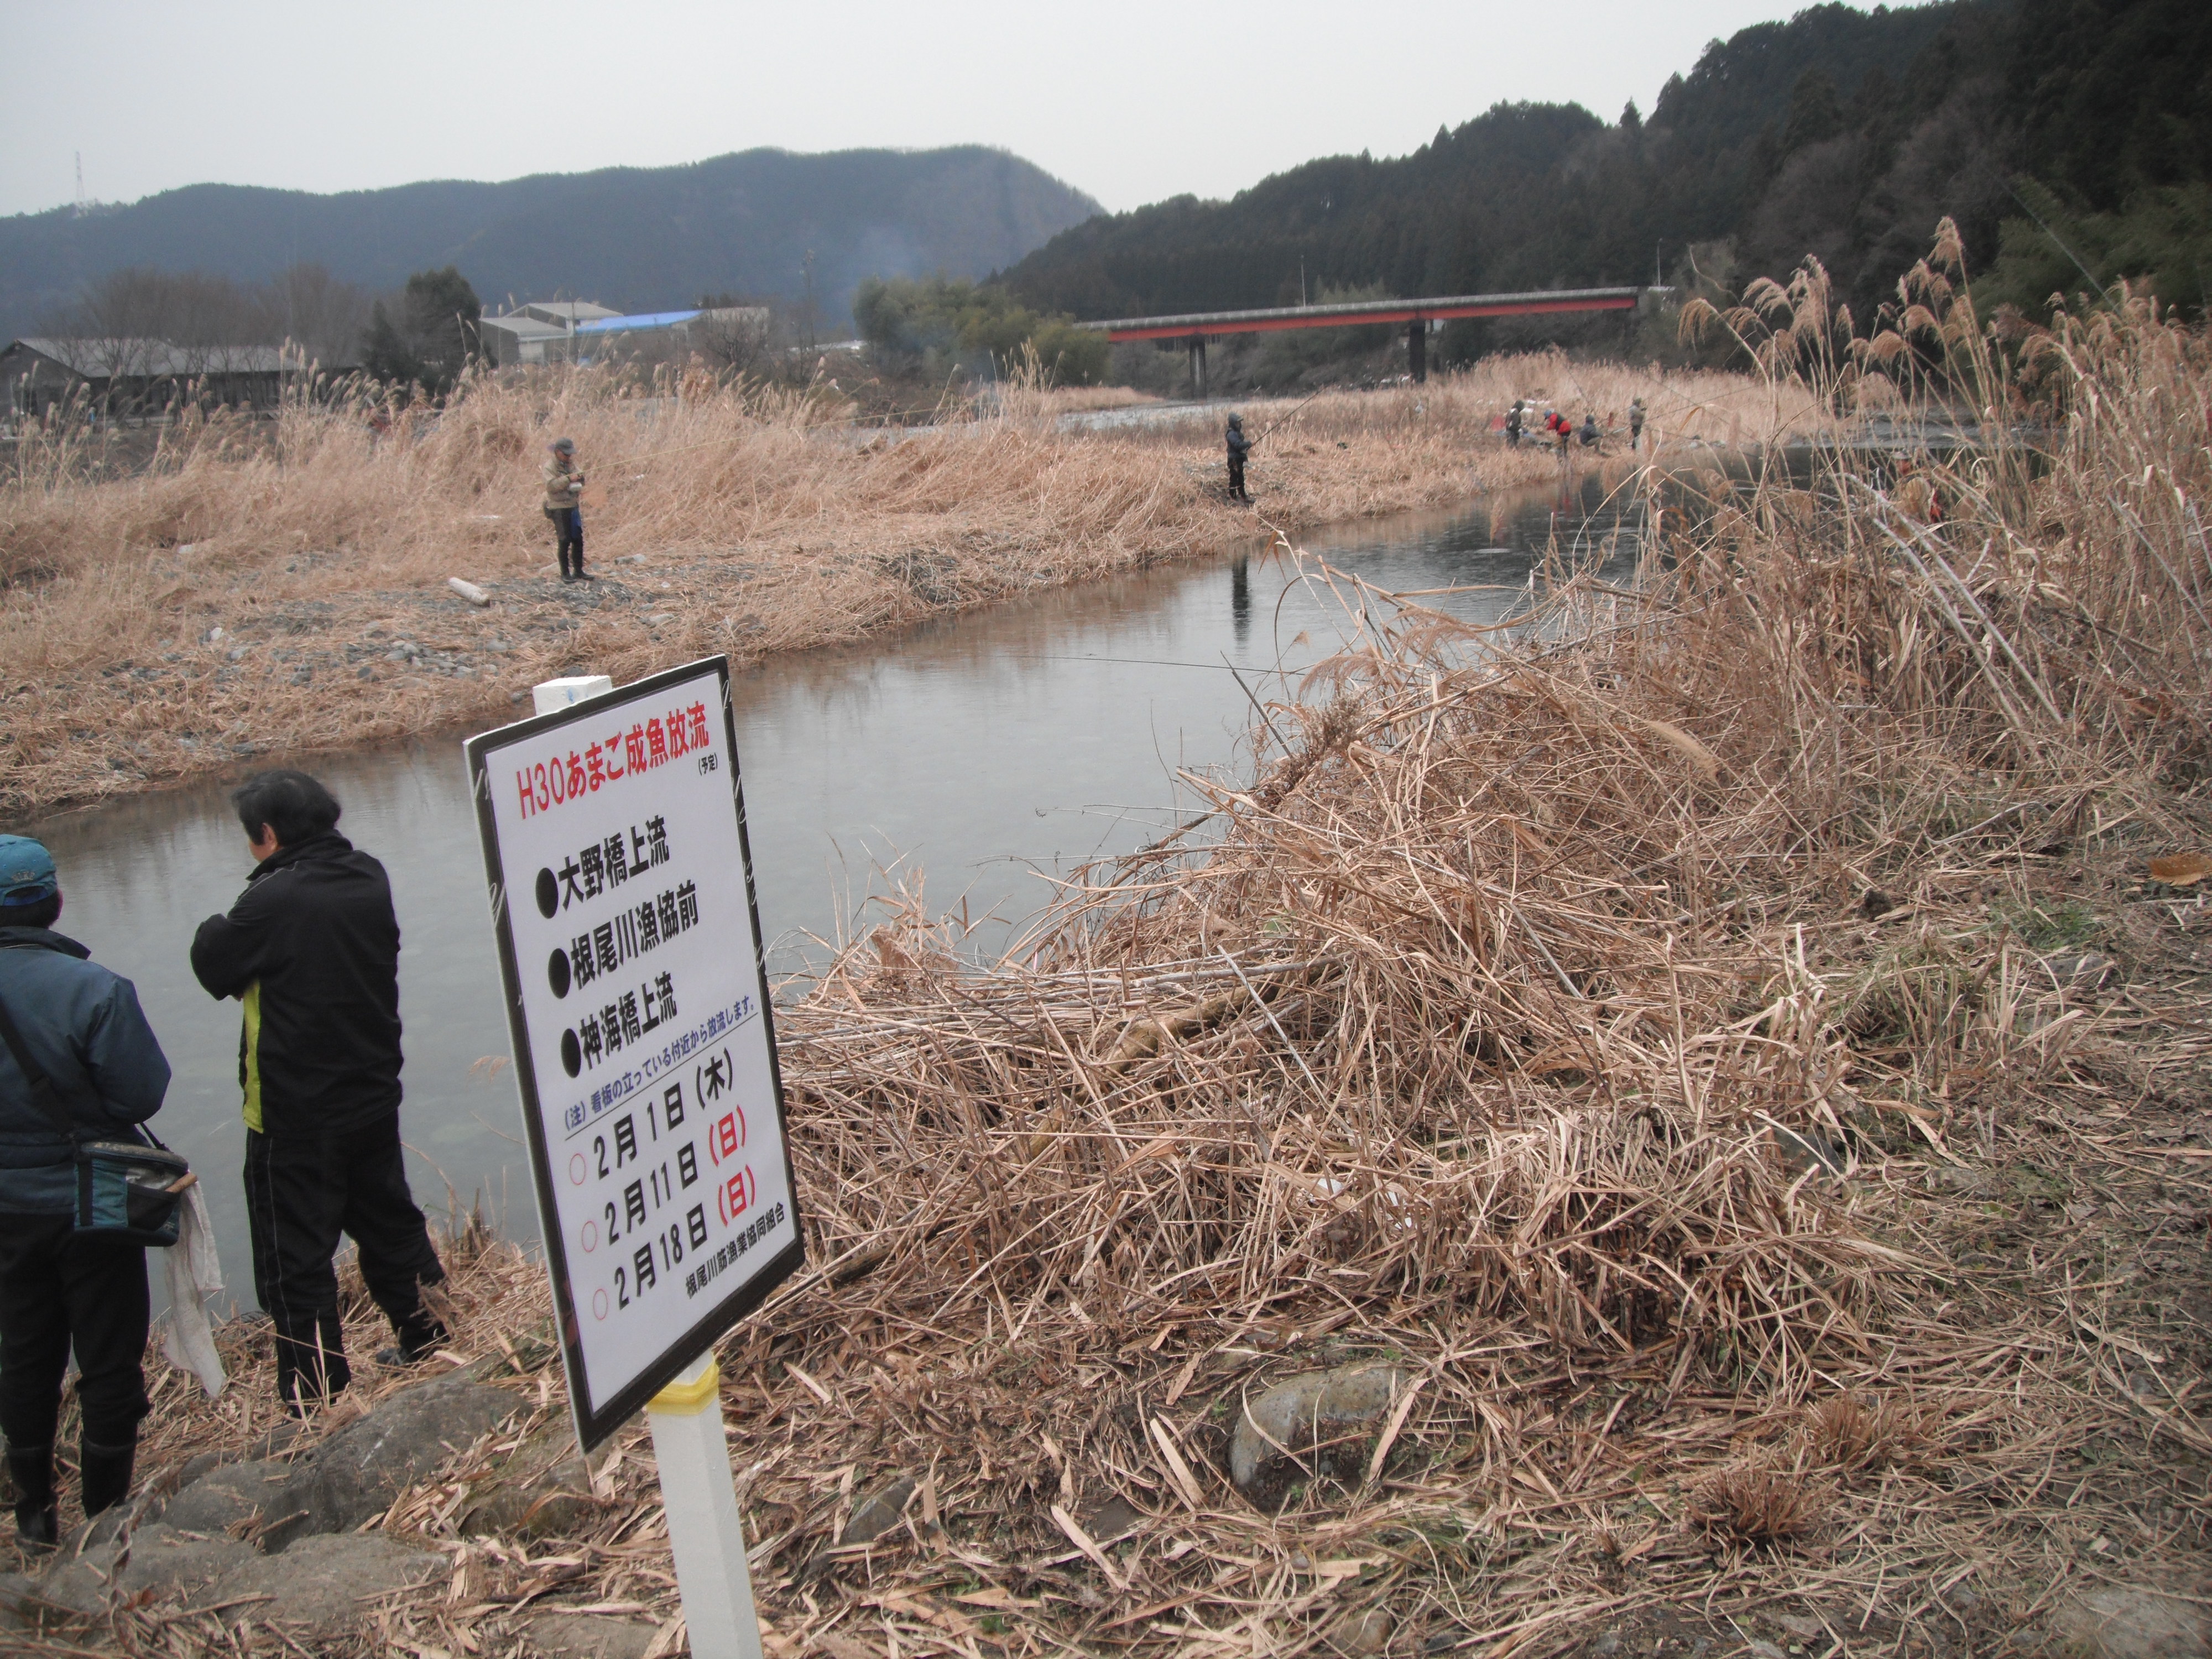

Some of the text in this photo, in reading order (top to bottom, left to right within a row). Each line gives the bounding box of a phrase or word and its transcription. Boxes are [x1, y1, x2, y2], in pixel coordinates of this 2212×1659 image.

[517, 701, 709, 820] H30あまご成魚放流
[698, 752, 718, 776] (予定)
[558, 815, 670, 911] 大野橋上流
[571, 879, 698, 990] 根尾川漁協前
[580, 971, 677, 1070] 神海橋上流
[686, 1202, 785, 1300] 根尾川筋漁業協同組合
